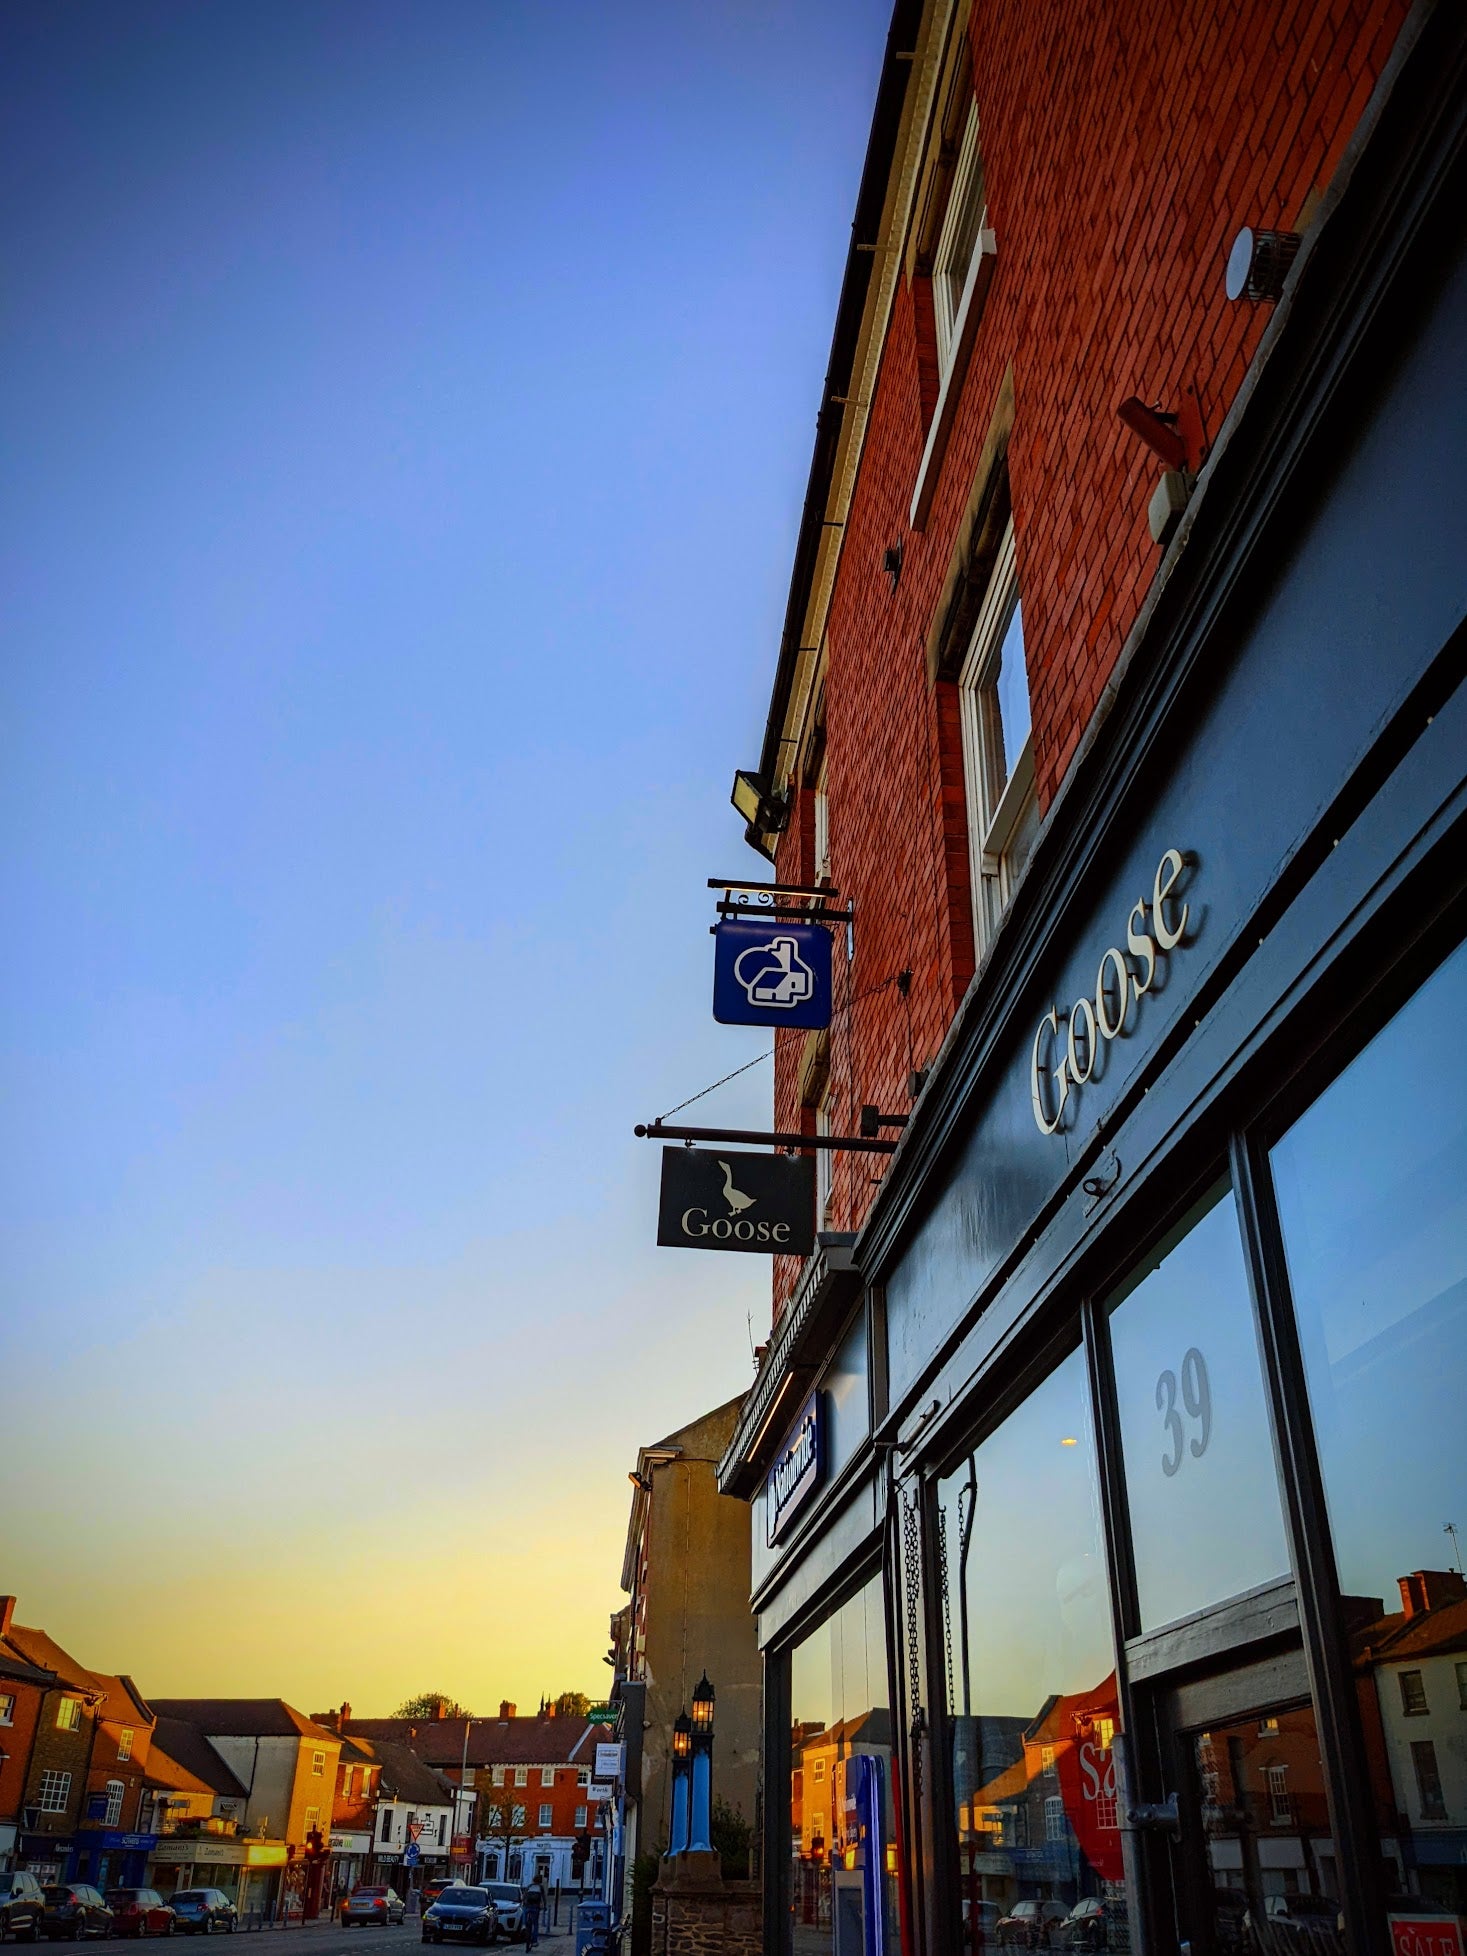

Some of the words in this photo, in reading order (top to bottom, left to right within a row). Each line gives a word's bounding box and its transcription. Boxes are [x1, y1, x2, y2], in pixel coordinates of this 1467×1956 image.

[1030, 848, 1189, 1136] Goose
[680, 1207, 791, 1244] Goose
[1155, 1347, 1211, 1478] 39
[774, 1415, 813, 1513] Nationwide
[589, 1711, 618, 1720] Specsaver
